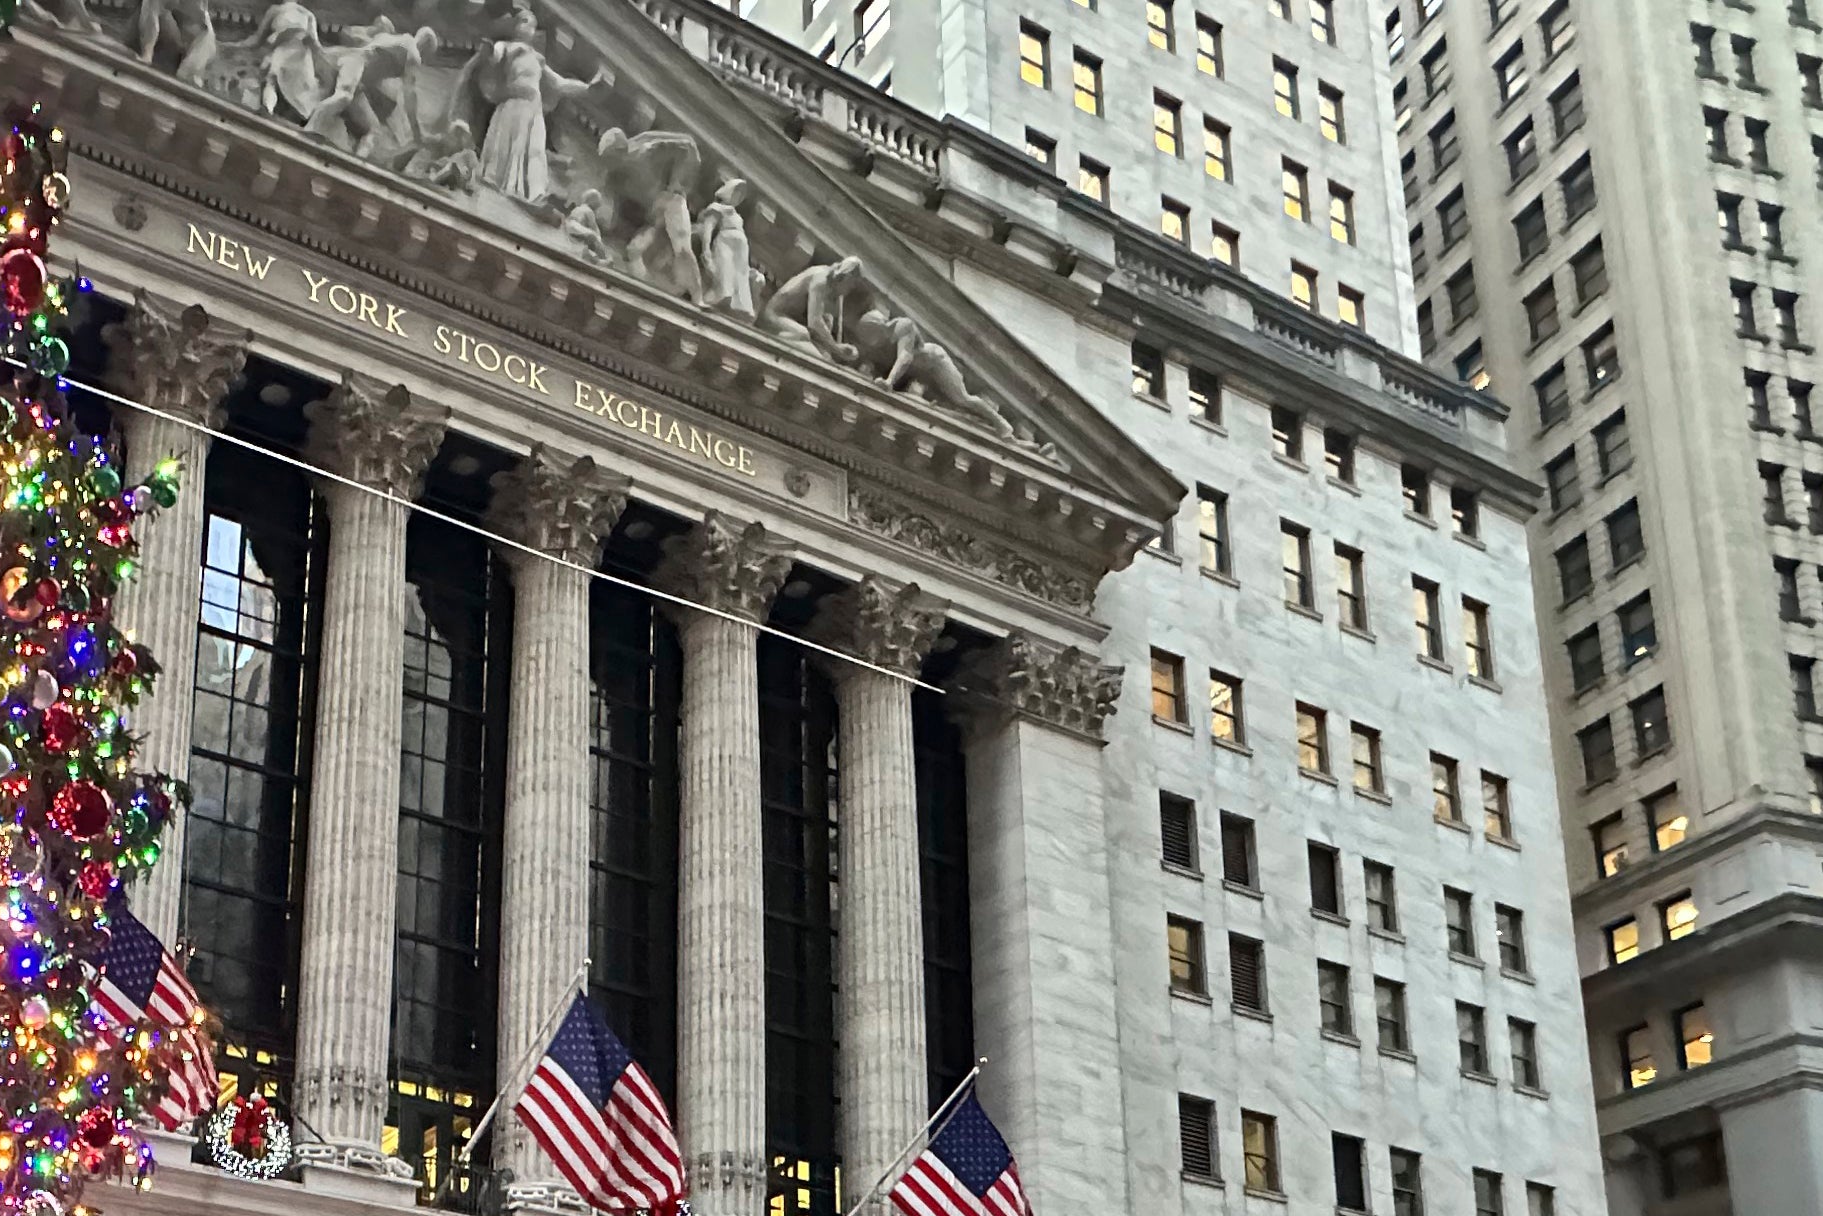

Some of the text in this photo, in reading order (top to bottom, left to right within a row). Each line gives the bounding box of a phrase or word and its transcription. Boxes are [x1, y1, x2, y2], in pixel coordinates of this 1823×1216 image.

[187, 223, 756, 476] NEW YORK STOCK EXCHANGE
